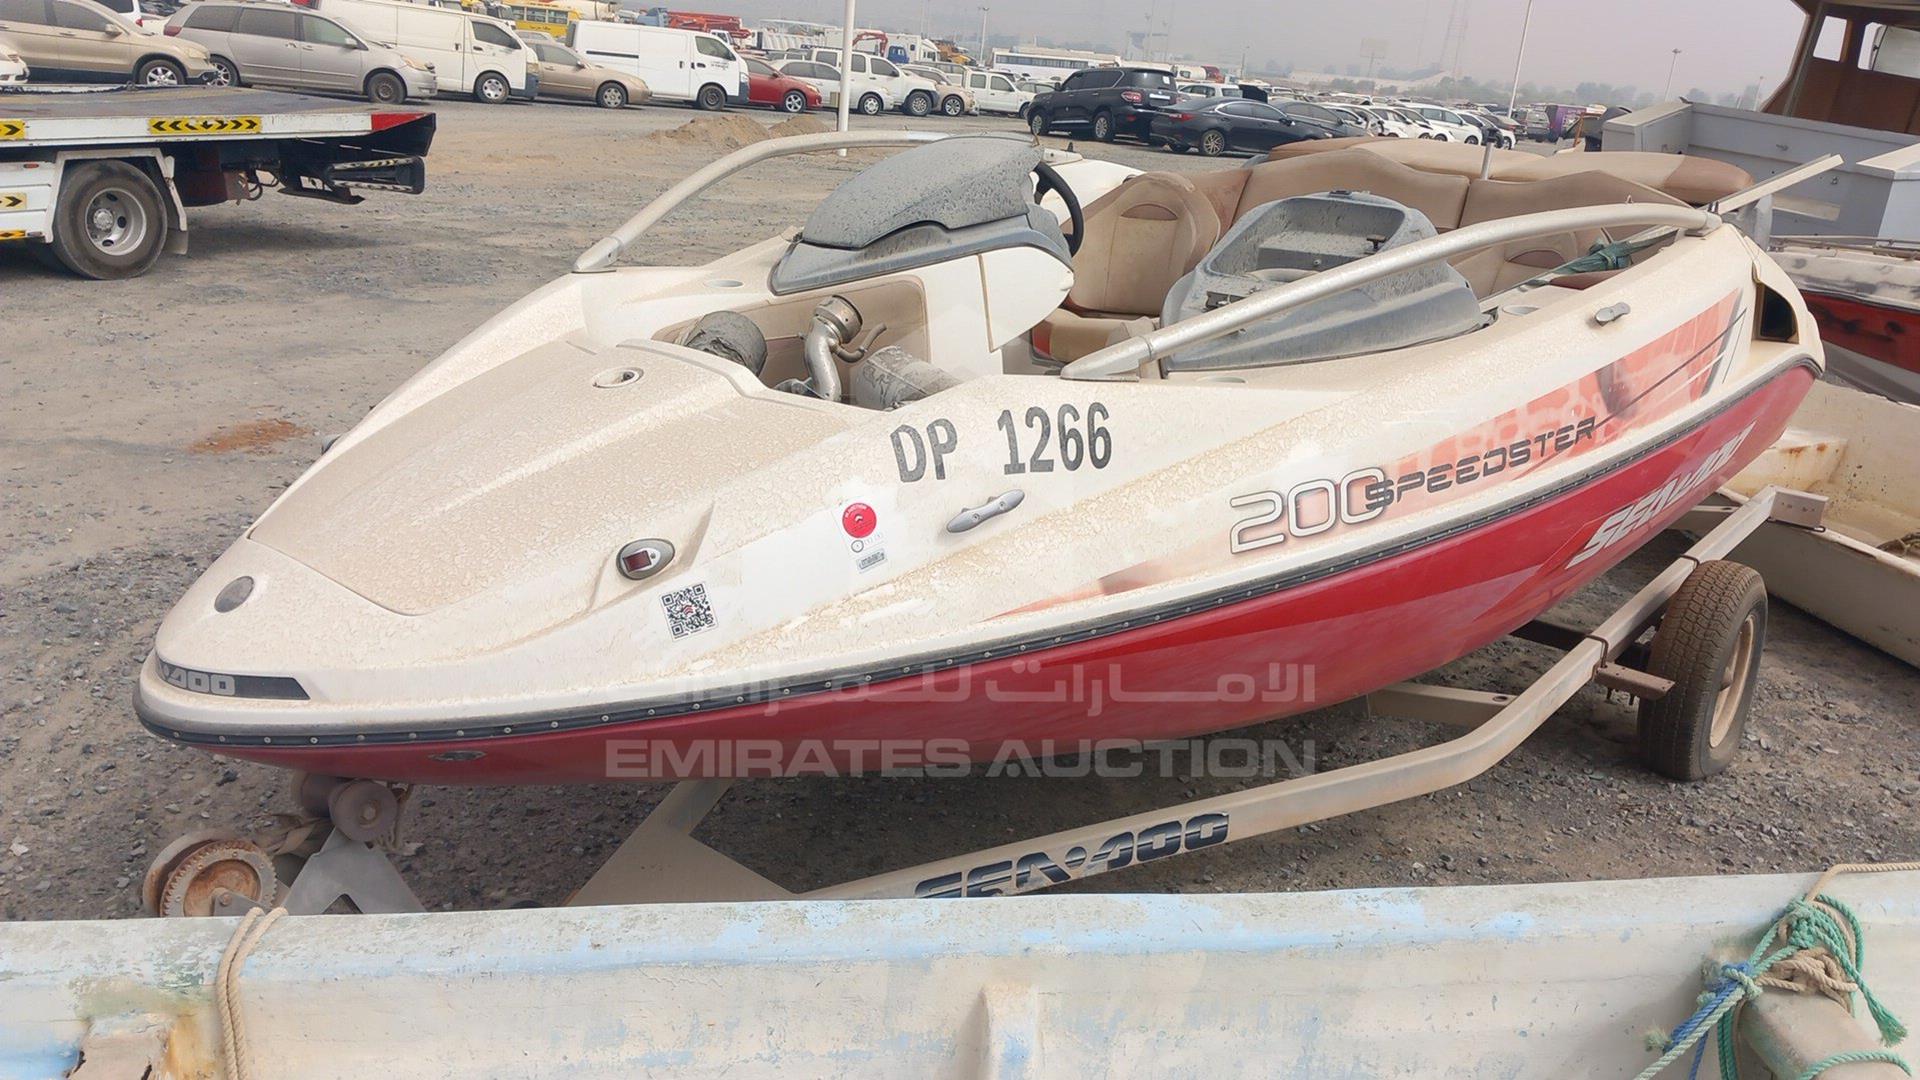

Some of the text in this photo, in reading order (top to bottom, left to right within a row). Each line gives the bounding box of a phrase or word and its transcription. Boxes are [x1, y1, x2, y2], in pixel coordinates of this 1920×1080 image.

[890, 402, 1112, 483] DP 1266
[1229, 417, 1596, 554] 200 SPEEDSTER
